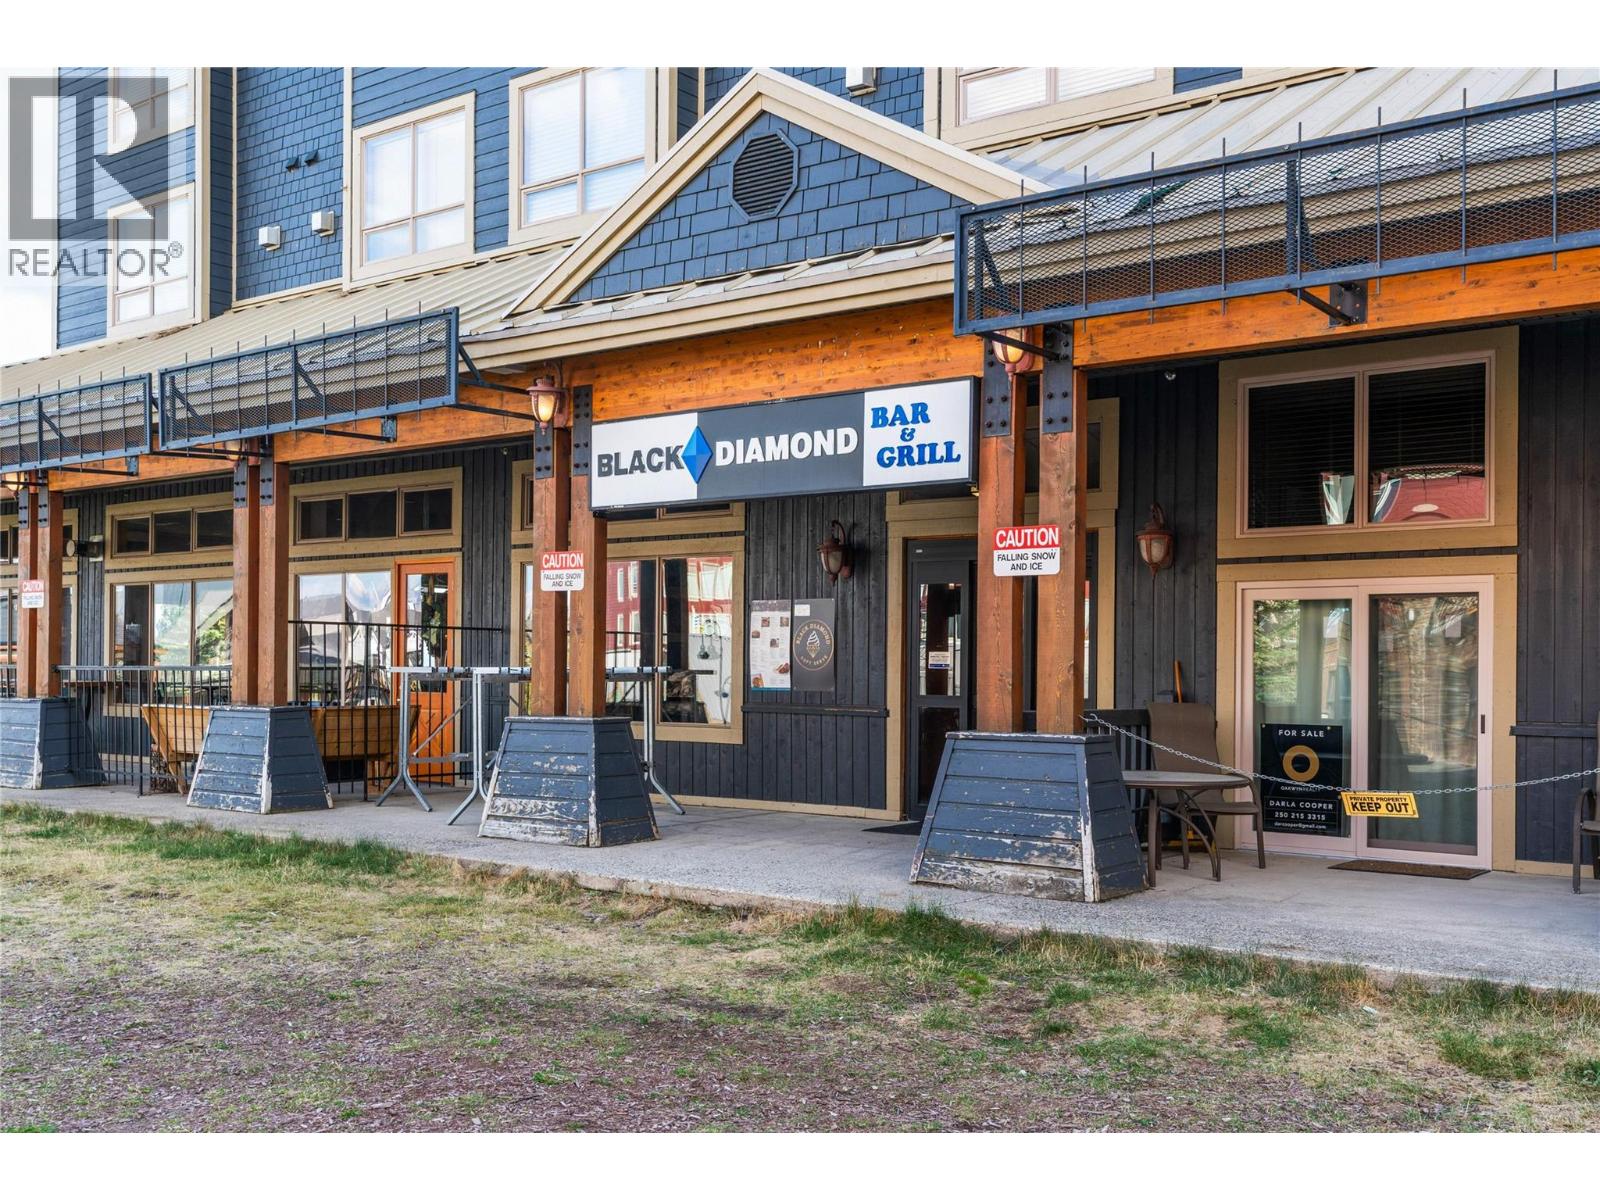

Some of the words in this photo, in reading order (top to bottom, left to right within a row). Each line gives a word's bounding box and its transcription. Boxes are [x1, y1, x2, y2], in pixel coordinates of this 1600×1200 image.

[871, 402, 931, 428] BAR
[900, 427, 916, 442] &
[597, 445, 684, 478] BLACK
[715, 427, 859, 467] DIAMOND
[876, 441, 961, 468] GRILL
[995, 527, 1059, 548] CAUTION
[542, 553, 584, 569] CAUTION
[997, 552, 1029, 561] FALLING
[1031, 552, 1056, 560] SNOW
[1010, 563, 1027, 571] AND
[1029, 562, 1043, 570] ICE
[796, 625, 809, 645] BLACK
[809, 623, 831, 645] DIAMOND
[1278, 729, 1297, 737] FOR
[1301, 729, 1325, 738] SALE
[1269, 800, 1296, 808] DARLA
[1299, 801, 1333, 810] COOPER
[1350, 802, 1381, 812] KEEP
[1385, 802, 1409, 813] OUT
